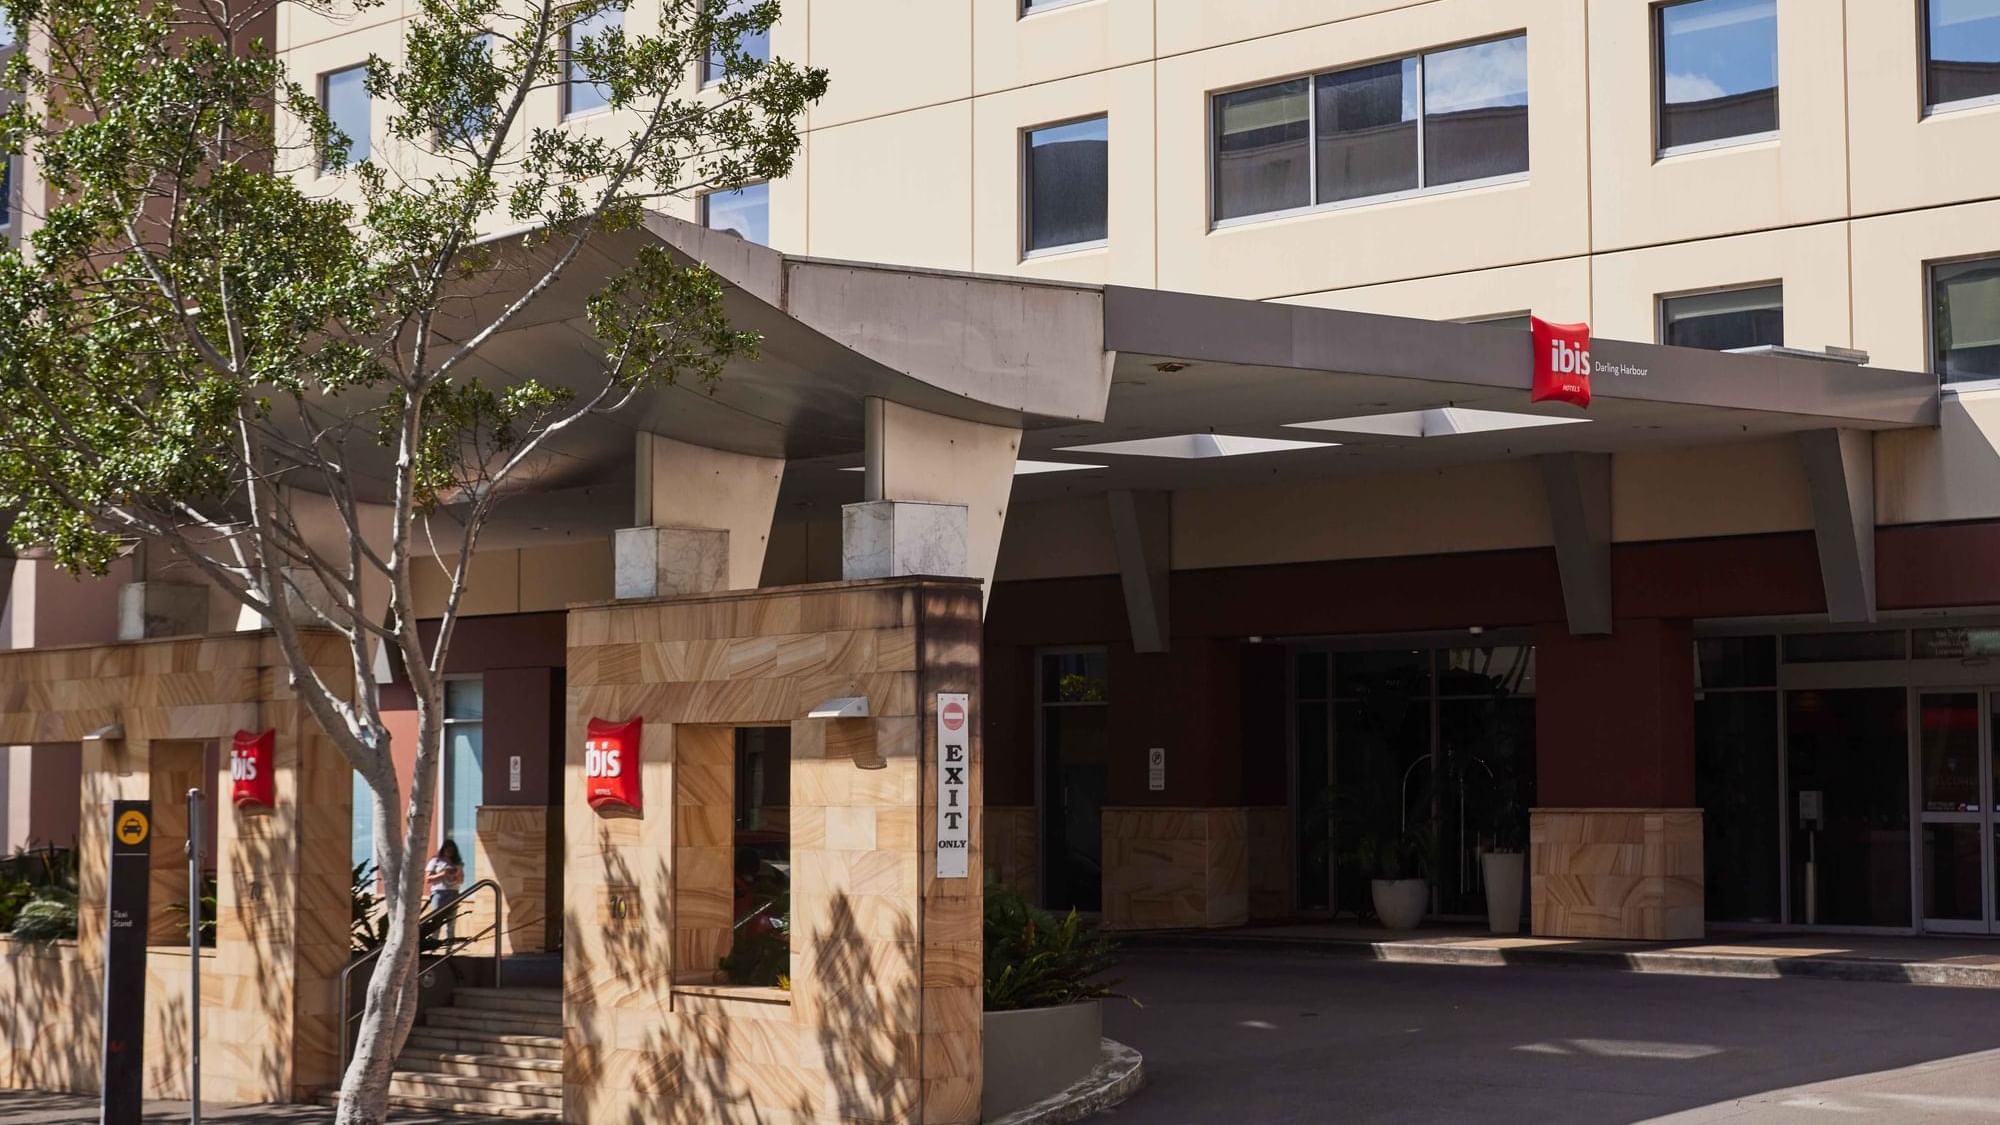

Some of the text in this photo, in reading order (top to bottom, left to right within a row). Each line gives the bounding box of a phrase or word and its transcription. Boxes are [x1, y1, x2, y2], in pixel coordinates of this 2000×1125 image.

[1551, 339, 1590, 376] ibis
[1595, 361, 1648, 376] Darling Harbour
[585, 741, 621, 777] ibis
[944, 744, 964, 830] EXIT
[938, 840, 967, 848] ONLY
[112, 910, 128, 918] Taxi
[112, 919, 133, 928] Stand
